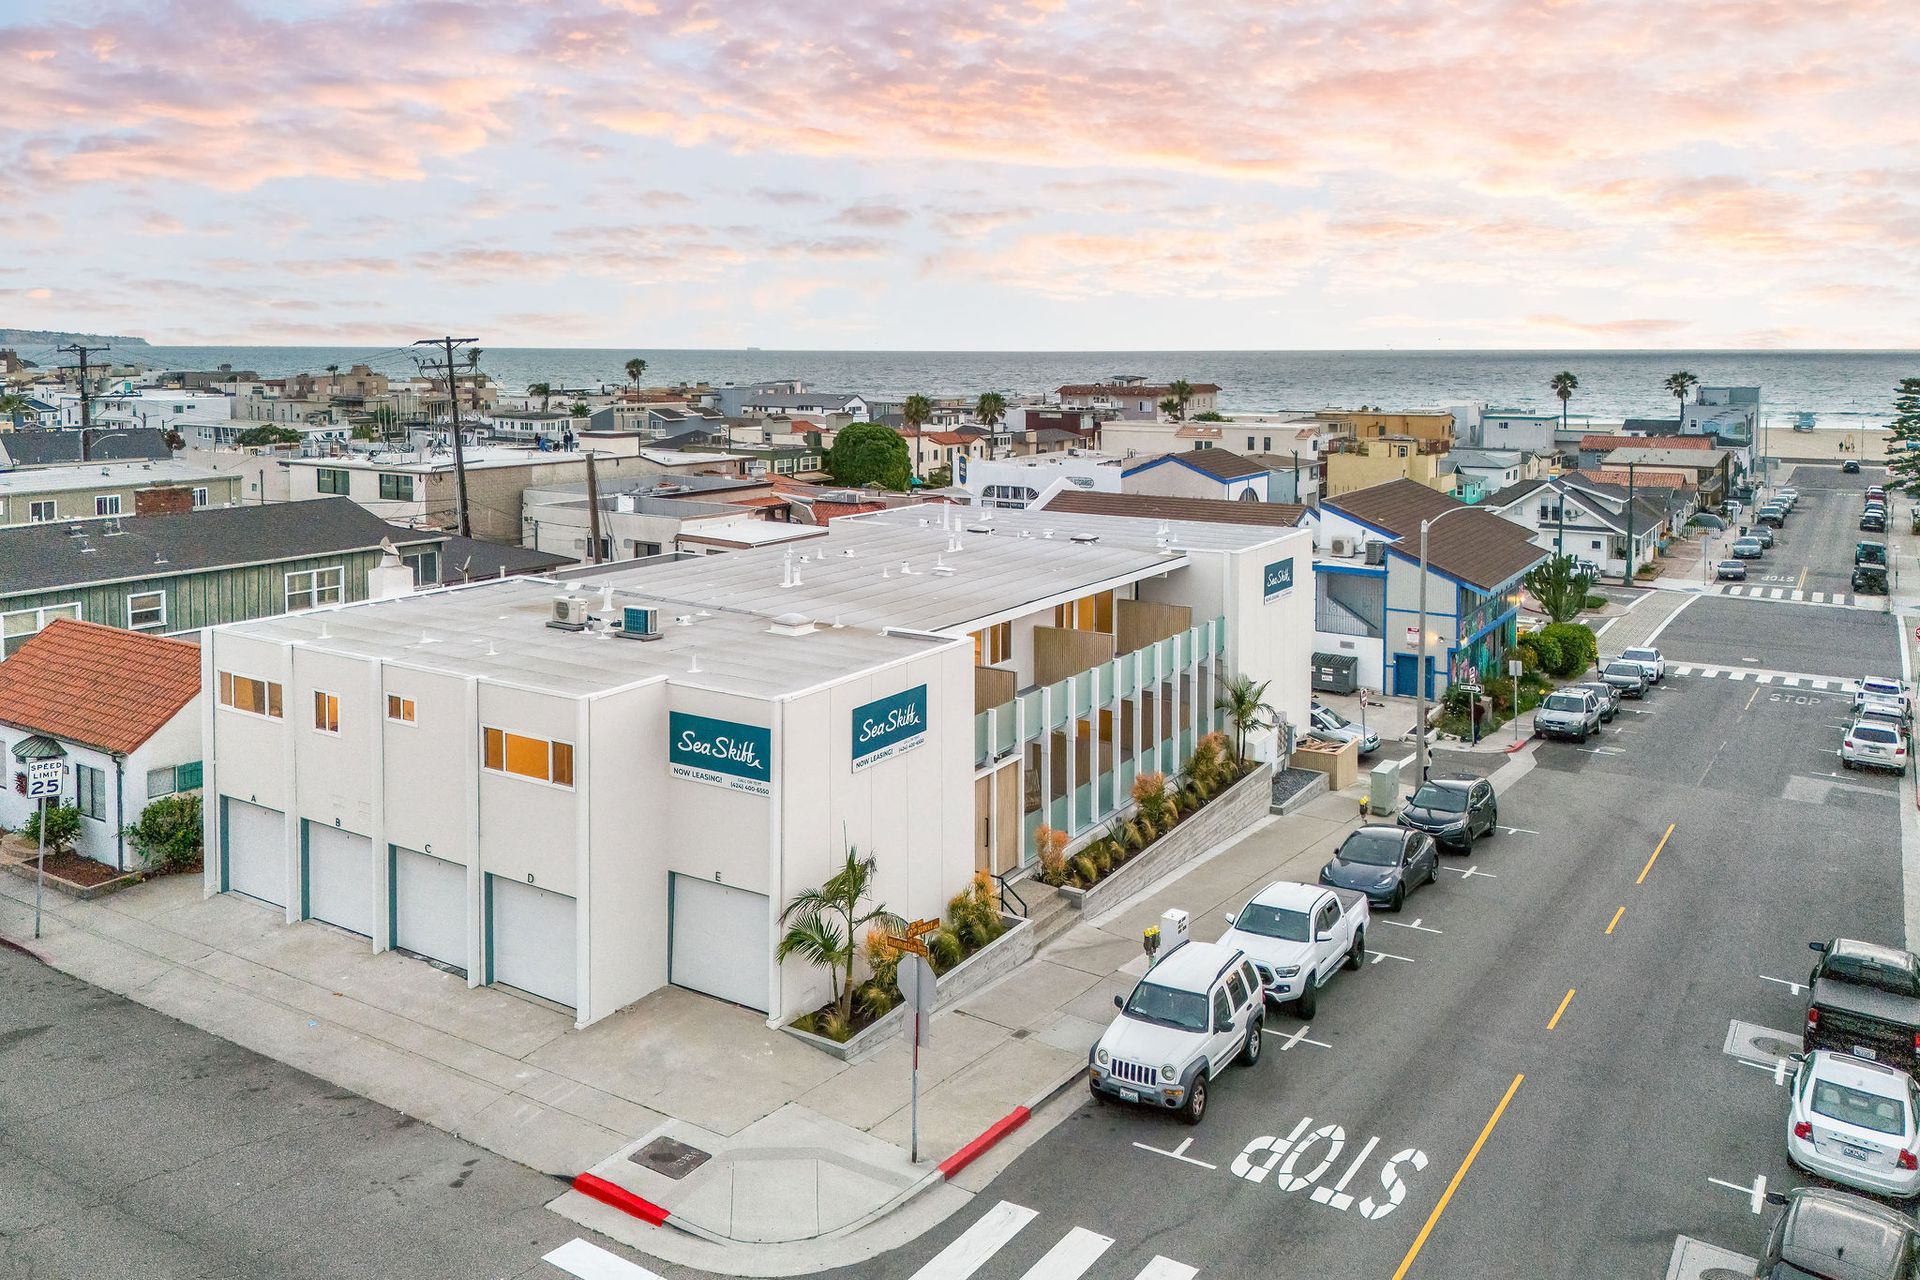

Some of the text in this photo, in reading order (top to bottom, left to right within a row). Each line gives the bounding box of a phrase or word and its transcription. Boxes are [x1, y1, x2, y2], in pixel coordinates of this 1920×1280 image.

[1769, 693, 1821, 706] STOP
[859, 718, 885, 742] Sea
[885, 703, 921, 732] Skiff
[677, 730, 764, 770] Sea Skiff
[855, 748, 894, 768] NOW LEASING!
[31, 762, 62, 771] SPEED
[33, 771, 59, 779] LIMIT
[673, 767, 723, 783] NOW LEASING!
[31, 779, 59, 795] 25
[730, 781, 744, 790] (424)
[250, 795, 256, 803] A
[335, 817, 341, 827] B
[424, 844, 431, 853] C
[527, 873, 535, 883] D
[715, 872, 721, 881] E
[1230, 1116, 1429, 1220] STOP
